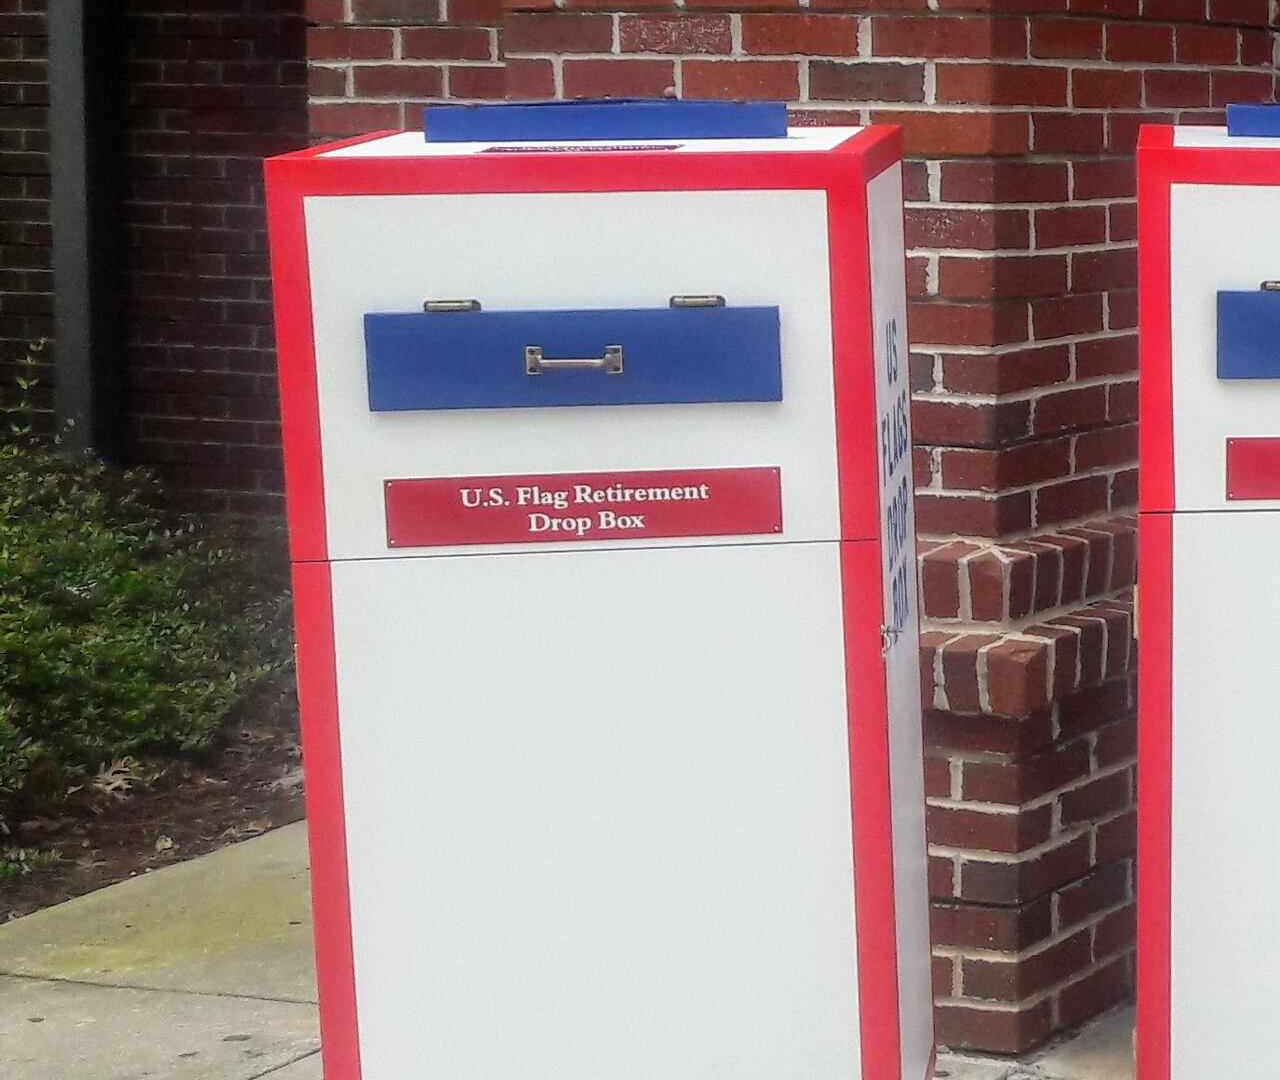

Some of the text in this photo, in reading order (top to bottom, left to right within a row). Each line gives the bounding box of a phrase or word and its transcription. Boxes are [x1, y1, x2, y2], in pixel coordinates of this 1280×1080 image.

[459, 483, 710, 510] U.S. Flag Retirement
[527, 511, 646, 536] Drop Box
